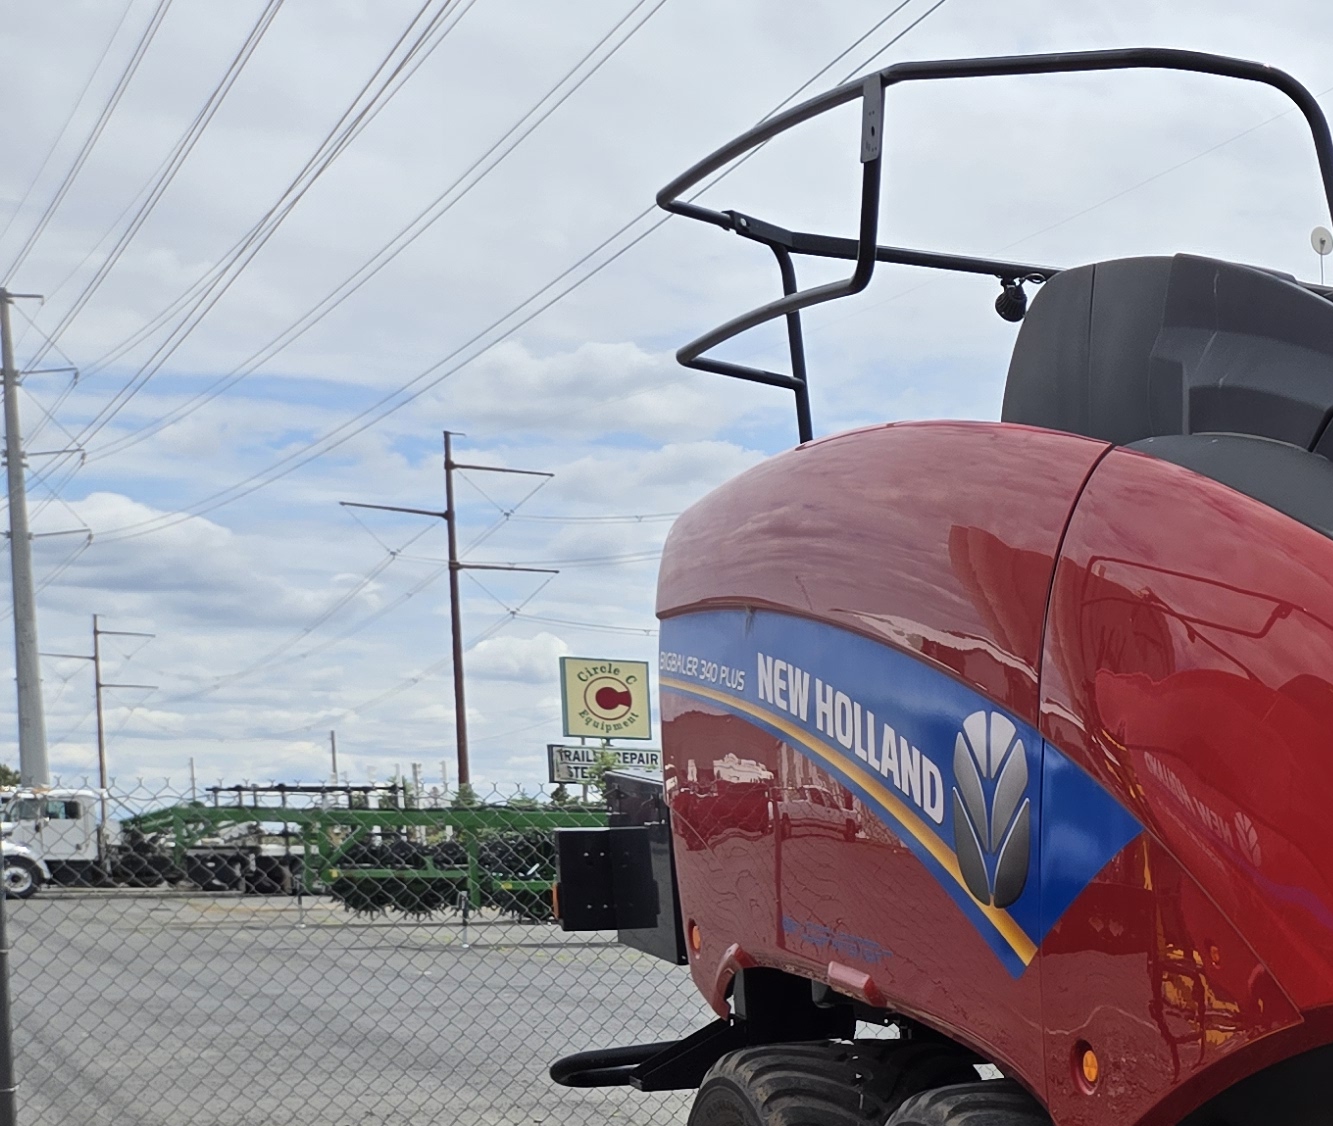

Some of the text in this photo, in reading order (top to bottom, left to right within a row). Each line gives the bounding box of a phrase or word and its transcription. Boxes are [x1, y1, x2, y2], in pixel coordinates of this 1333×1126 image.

[577, 662, 638, 685] Circle C
[699, 659, 719, 683] 340
[720, 665, 746, 691] PLUS
[578, 709, 640, 734] Equipment
[757, 652, 945, 825] NEW HOLLAND
